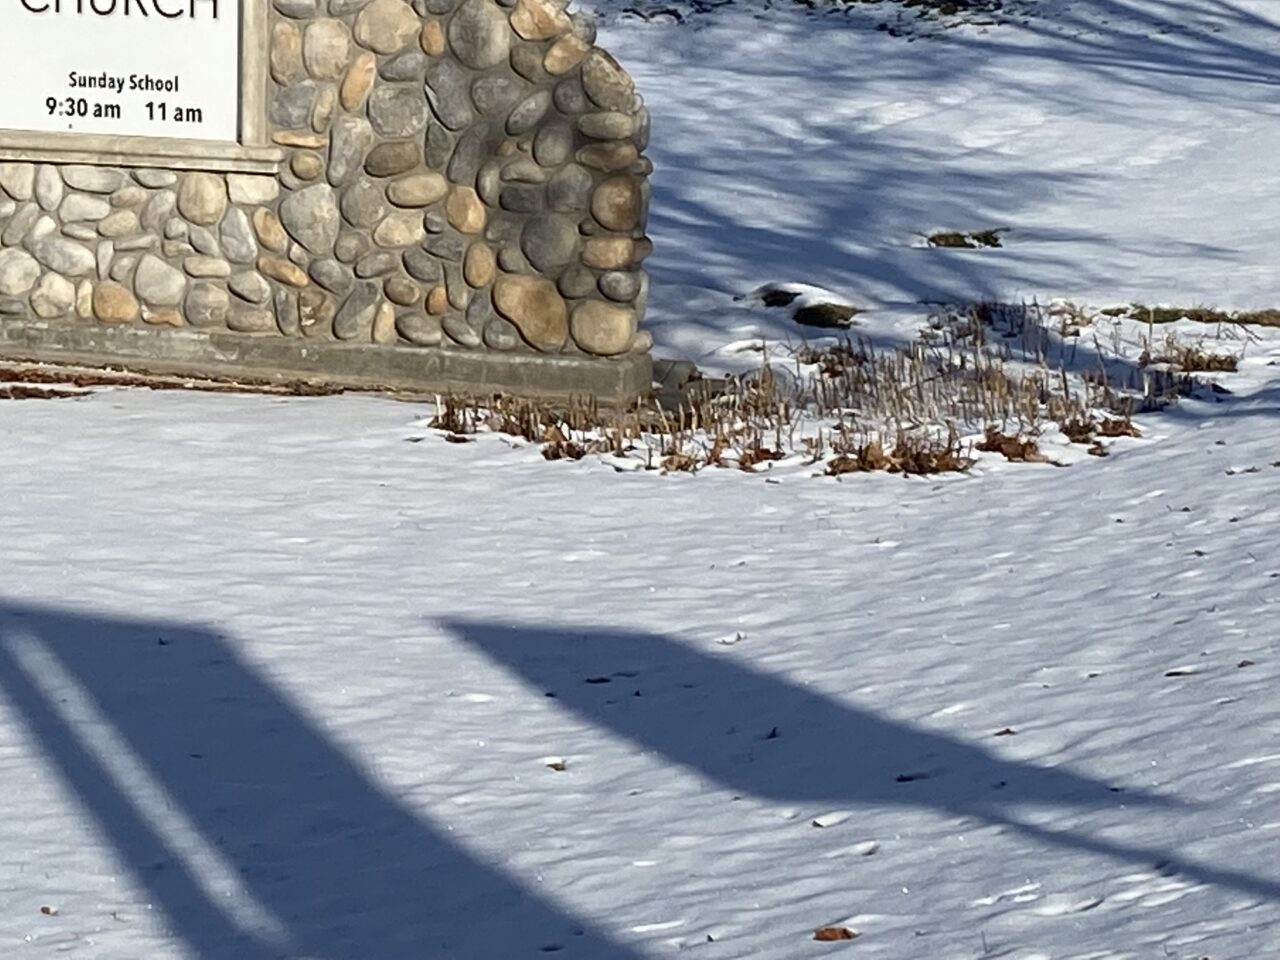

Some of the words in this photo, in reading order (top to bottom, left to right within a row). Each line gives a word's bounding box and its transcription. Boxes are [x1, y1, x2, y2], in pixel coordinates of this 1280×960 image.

[68, 71, 125, 94] Sunday
[129, 74, 179, 92] School
[45, 96, 88, 117] 9:30
[92, 103, 121, 119] am
[145, 101, 166, 121] 11
[173, 106, 203, 123] am
